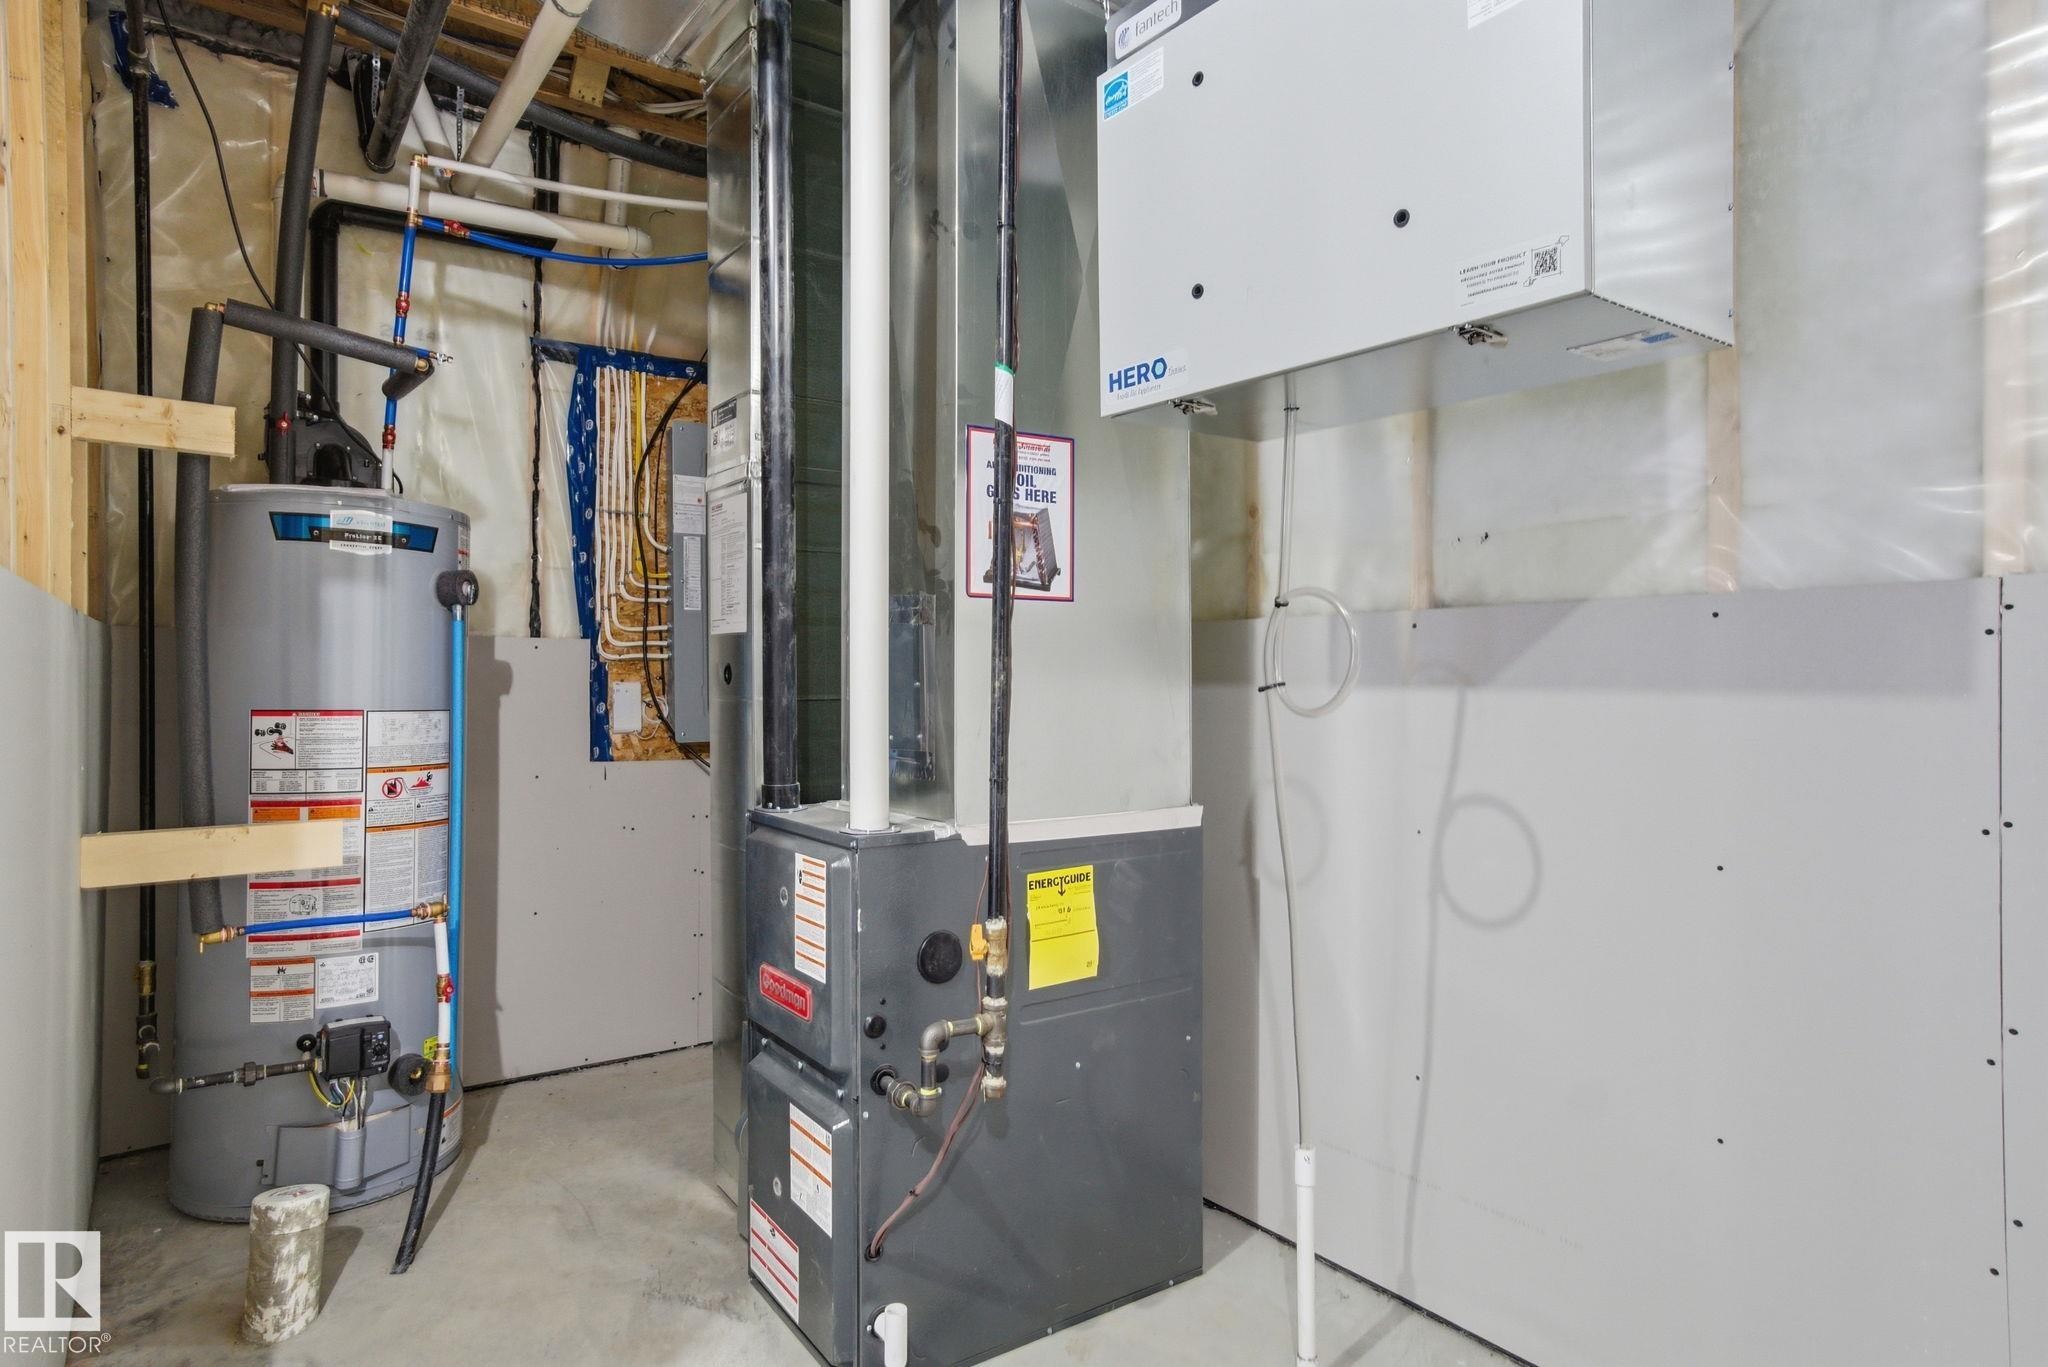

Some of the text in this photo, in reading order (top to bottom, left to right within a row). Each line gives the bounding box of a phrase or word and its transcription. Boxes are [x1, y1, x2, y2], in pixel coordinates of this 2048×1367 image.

[1135, 0, 1178, 36] fantech
[1108, 357, 1168, 393] HERO
[1016, 473, 1037, 488] OIL
[1025, 487, 1057, 504] HERE
[762, 976, 806, 1011] Goodman
